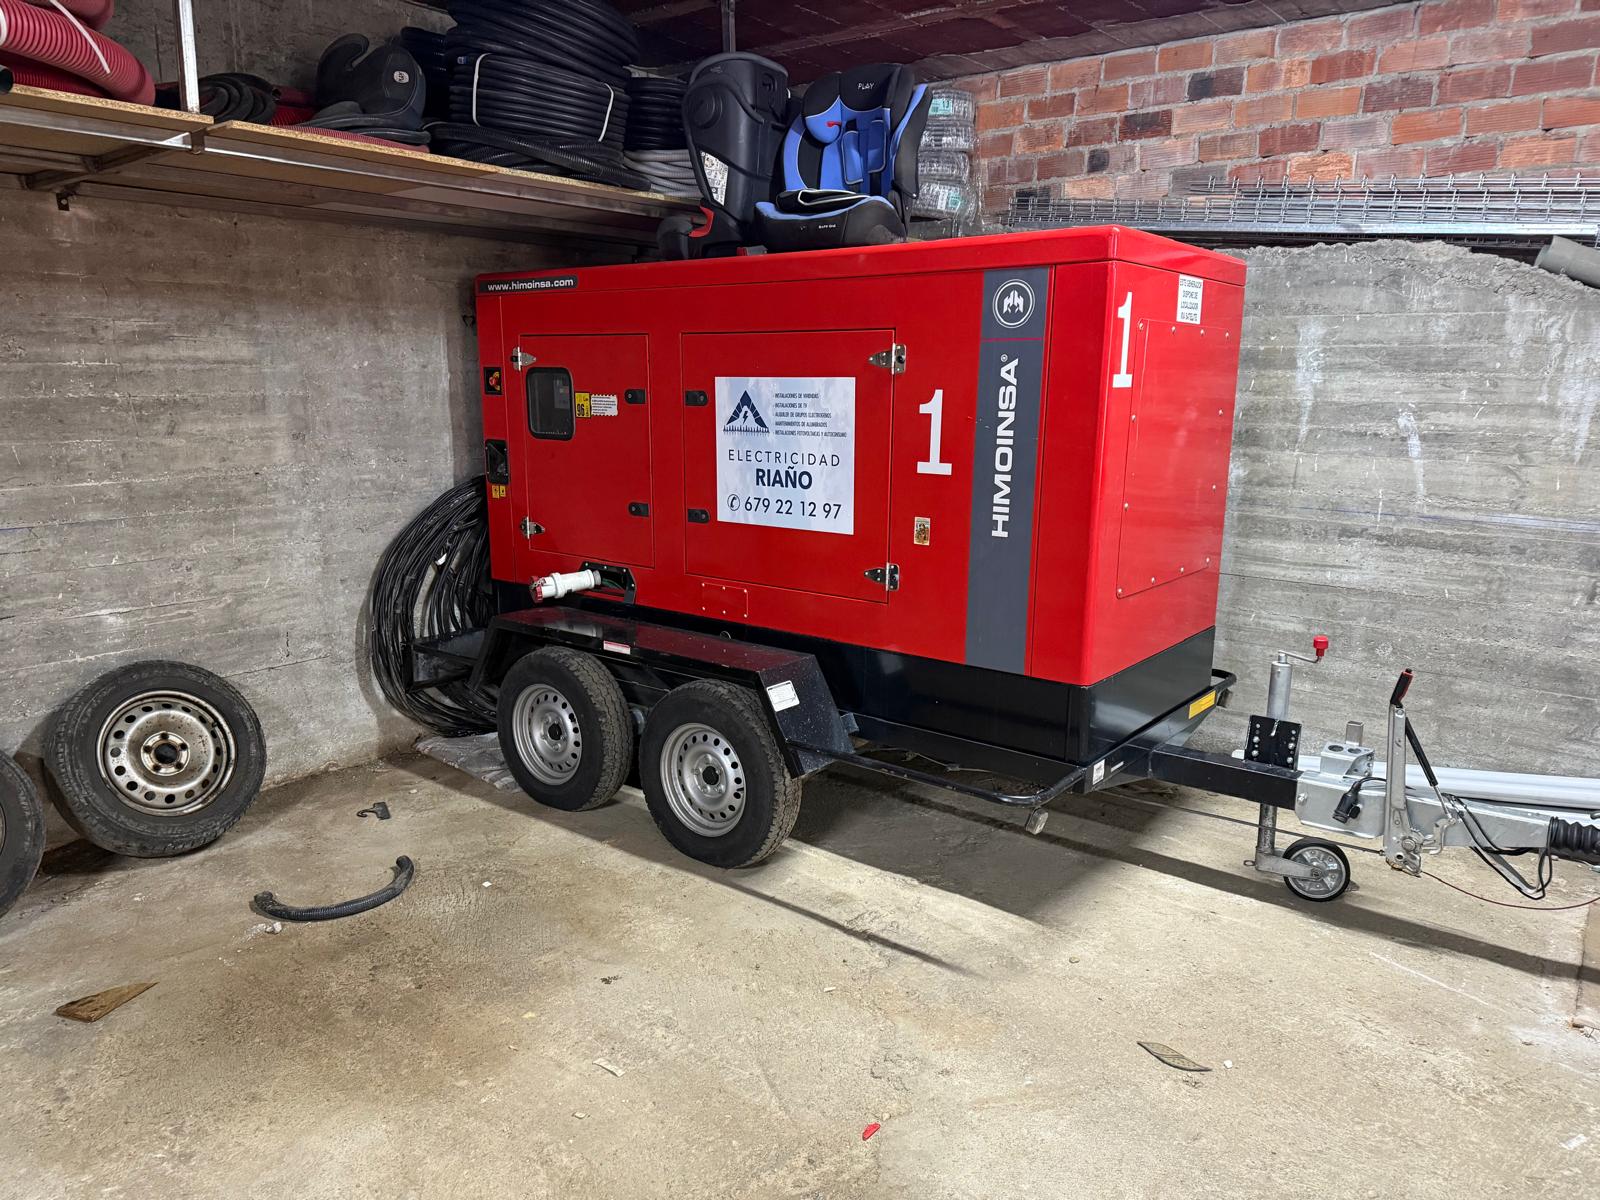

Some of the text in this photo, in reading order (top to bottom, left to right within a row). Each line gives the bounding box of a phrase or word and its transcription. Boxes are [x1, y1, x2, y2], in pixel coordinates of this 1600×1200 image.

[857, 82, 875, 90] PLAY
[487, 279, 574, 291] www.himoinsa.com
[1112, 291, 1133, 388] 1
[917, 389, 952, 476] 1
[728, 449, 841, 467] ELECTRICIDAD
[755, 465, 813, 490] RIAÑO
[744, 496, 842, 519] 679 22 12 97
